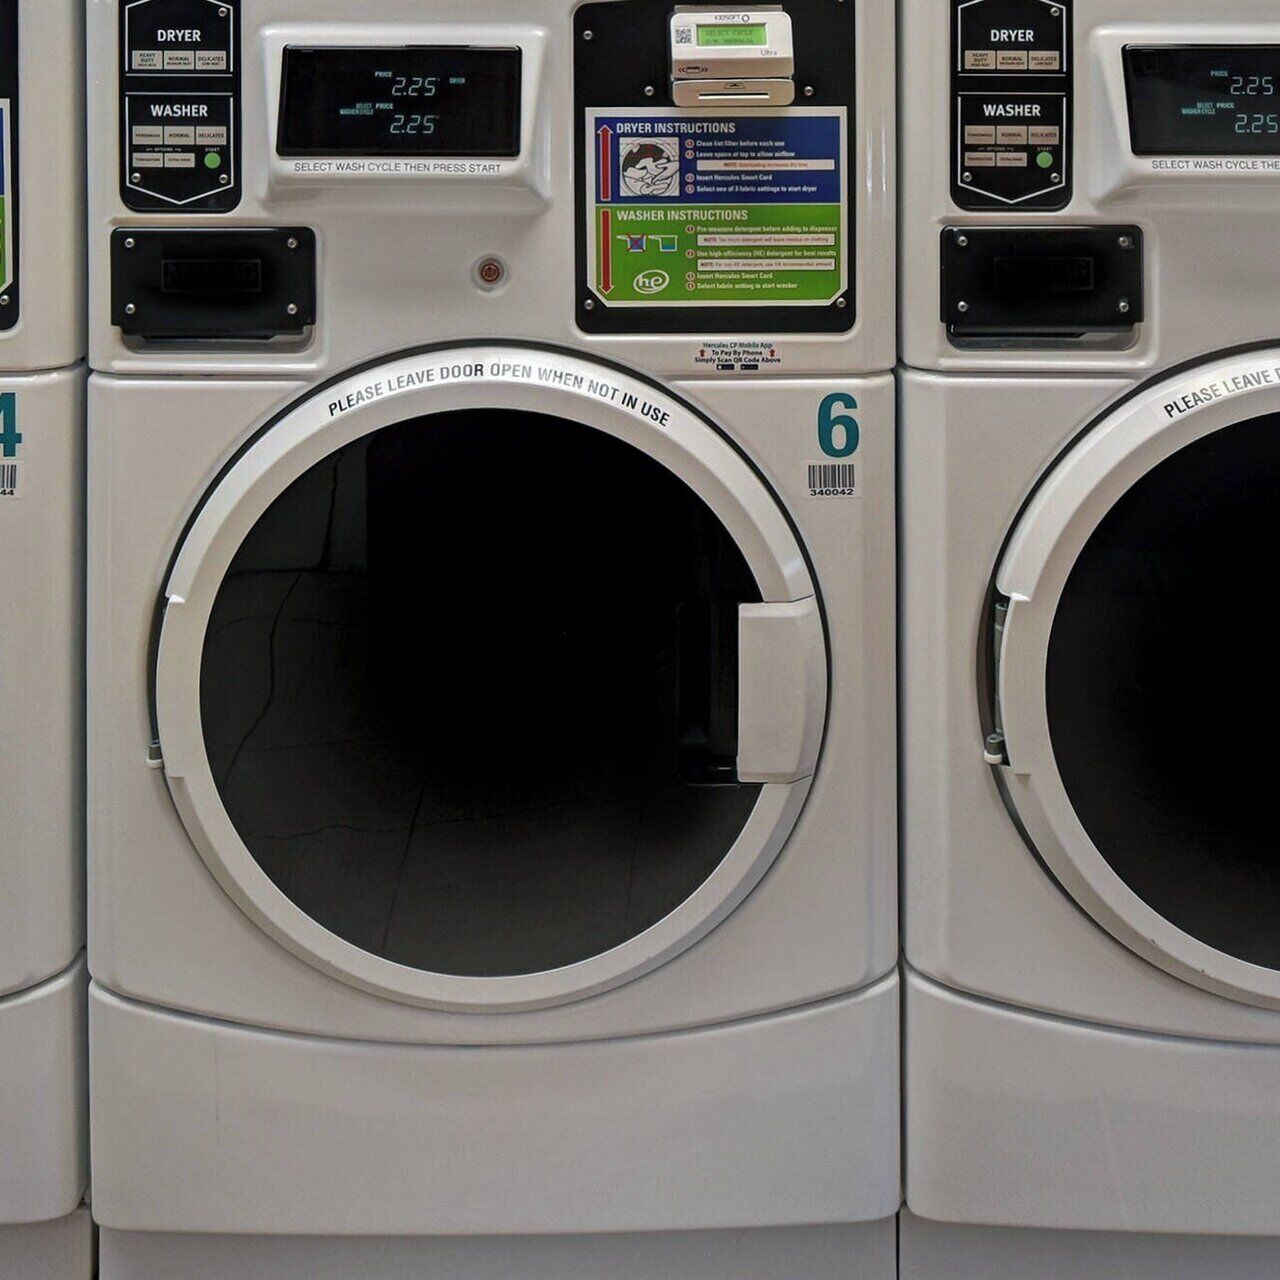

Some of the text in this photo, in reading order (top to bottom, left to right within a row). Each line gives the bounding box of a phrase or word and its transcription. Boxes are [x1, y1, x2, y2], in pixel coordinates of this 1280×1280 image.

[157, 29, 201, 41] DRYER
[991, 29, 1034, 41] DRYER
[392, 77, 436, 96] 2.25
[1230, 76, 1274, 95] 2.25
[151, 104, 208, 117] WASHER
[983, 104, 1041, 116] WASHER
[390, 115, 436, 134] 2.25
[616, 122, 736, 133] DRYER INSTRUCTIONS
[1235, 114, 1278, 133] 2.25
[294, 162, 501, 173] SELECT WASH CYCLE THEN PRESS START
[1151, 160, 1190, 170] SELECT
[1192, 160, 1223, 170] WASH
[1225, 160, 1258, 170] CYCLE
[617, 209, 748, 220] WASHER INSTRUCTIONS
[328, 363, 671, 427] PLEASE LEAVE DOOR OPEN WHEN NOT IN USE
[1163, 383, 1222, 418] PLEASE
[1222, 369, 1274, 394] LEAVE
[817, 392, 860, 458] 6
[810, 488, 854, 496] 340042
